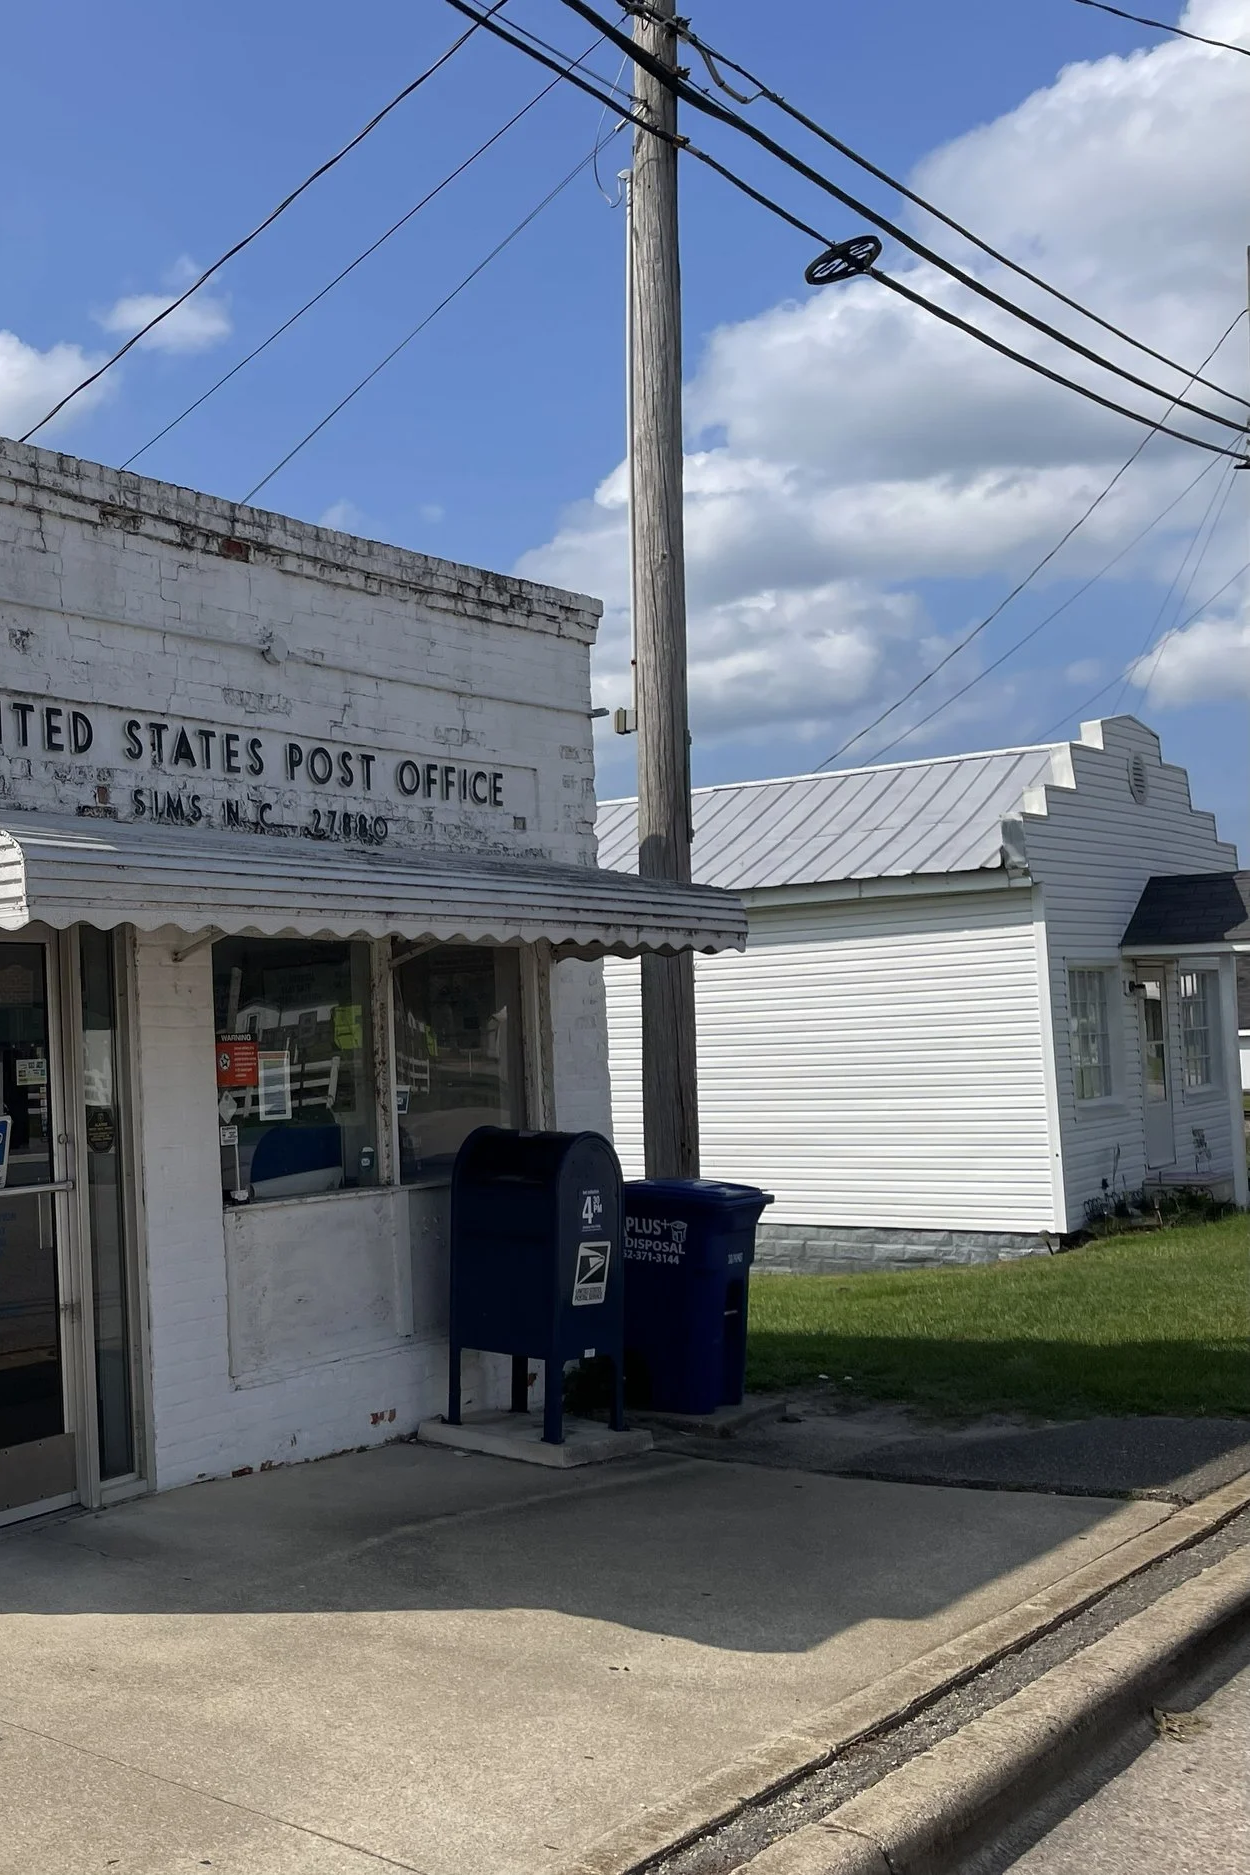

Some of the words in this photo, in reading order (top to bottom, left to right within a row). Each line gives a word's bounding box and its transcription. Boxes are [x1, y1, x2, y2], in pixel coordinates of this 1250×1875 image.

[125, 718, 265, 776] STATES
[286, 742, 376, 791] POST
[397, 759, 504, 807] OFFICE
[132, 788, 203, 822] SIMS
[311, 808, 389, 841] 27880
[220, 1034, 251, 1042] WARNING
[582, 1196, 594, 1224] 4
[593, 1203, 603, 1214] PM
[624, 1237, 686, 1255] DISPOSAL
